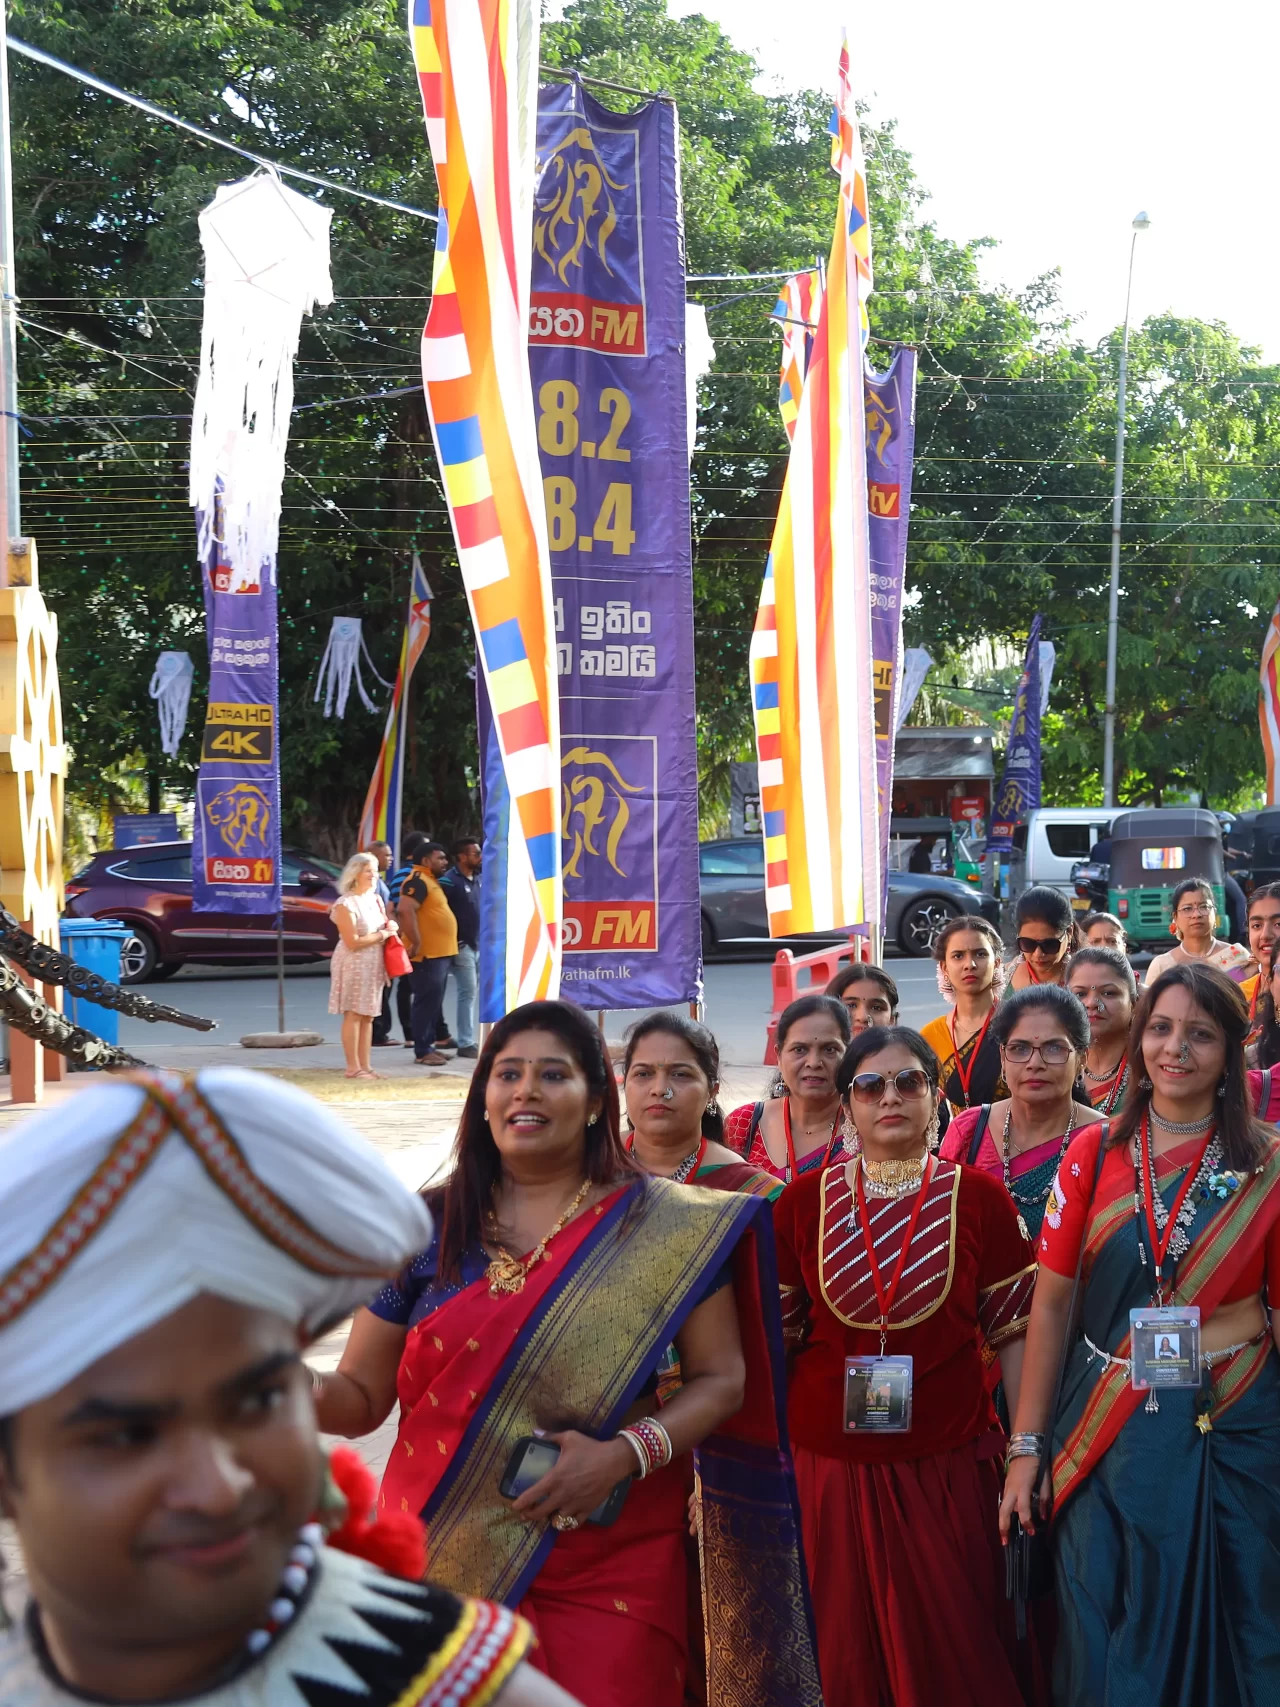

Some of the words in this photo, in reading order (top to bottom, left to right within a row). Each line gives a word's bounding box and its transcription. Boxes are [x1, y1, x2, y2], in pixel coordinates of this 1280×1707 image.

[591, 306, 638, 346] FM
[870, 485, 898, 515] tv
[580, 600, 651, 641] ඉතිං
[580, 644, 656, 678] තමයි
[245, 708, 272, 723] HD
[211, 730, 262, 755] 4K
[591, 909, 651, 945] FM
